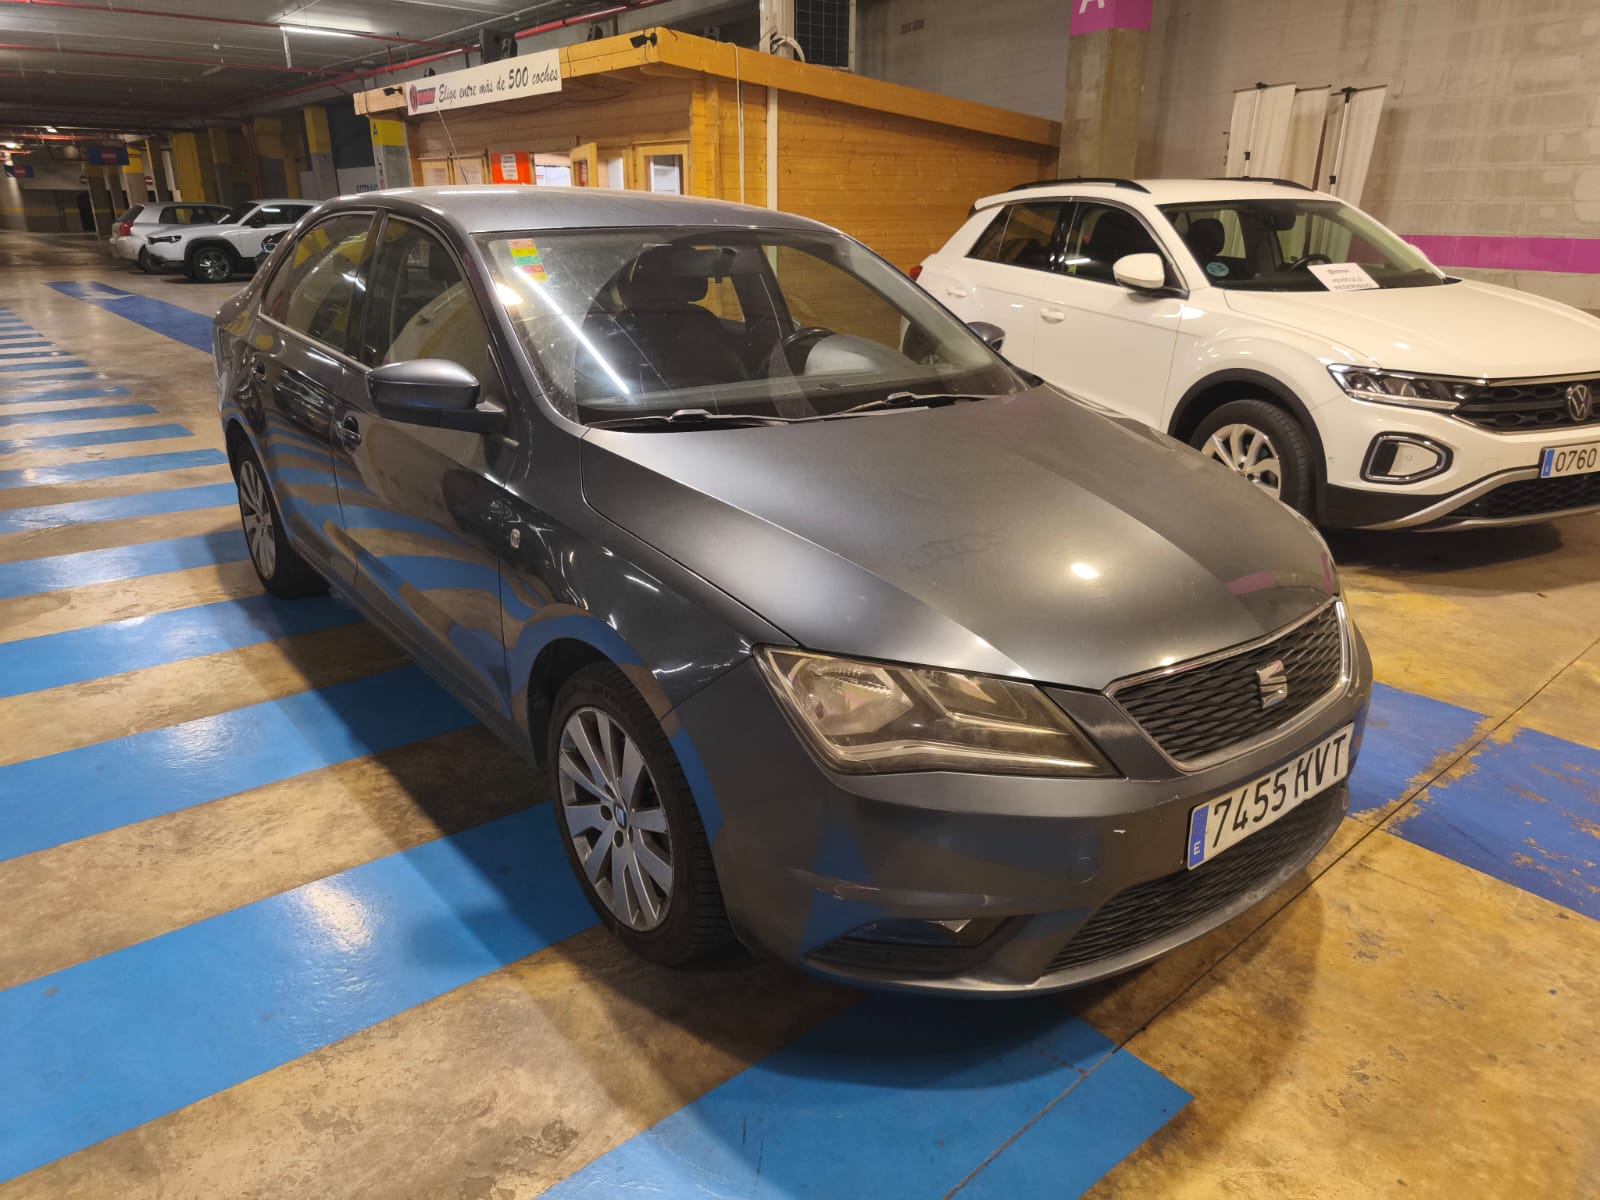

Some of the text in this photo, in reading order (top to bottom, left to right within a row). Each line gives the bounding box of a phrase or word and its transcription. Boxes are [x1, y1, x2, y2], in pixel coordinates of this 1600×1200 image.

[439, 83, 457, 105] Elige
[459, 84, 477, 99] entre
[479, 79, 493, 94] más
[496, 75, 505, 91] de
[508, 66, 529, 90] 500
[531, 63, 559, 85] coches
[1555, 447, 1598, 473] 0760
